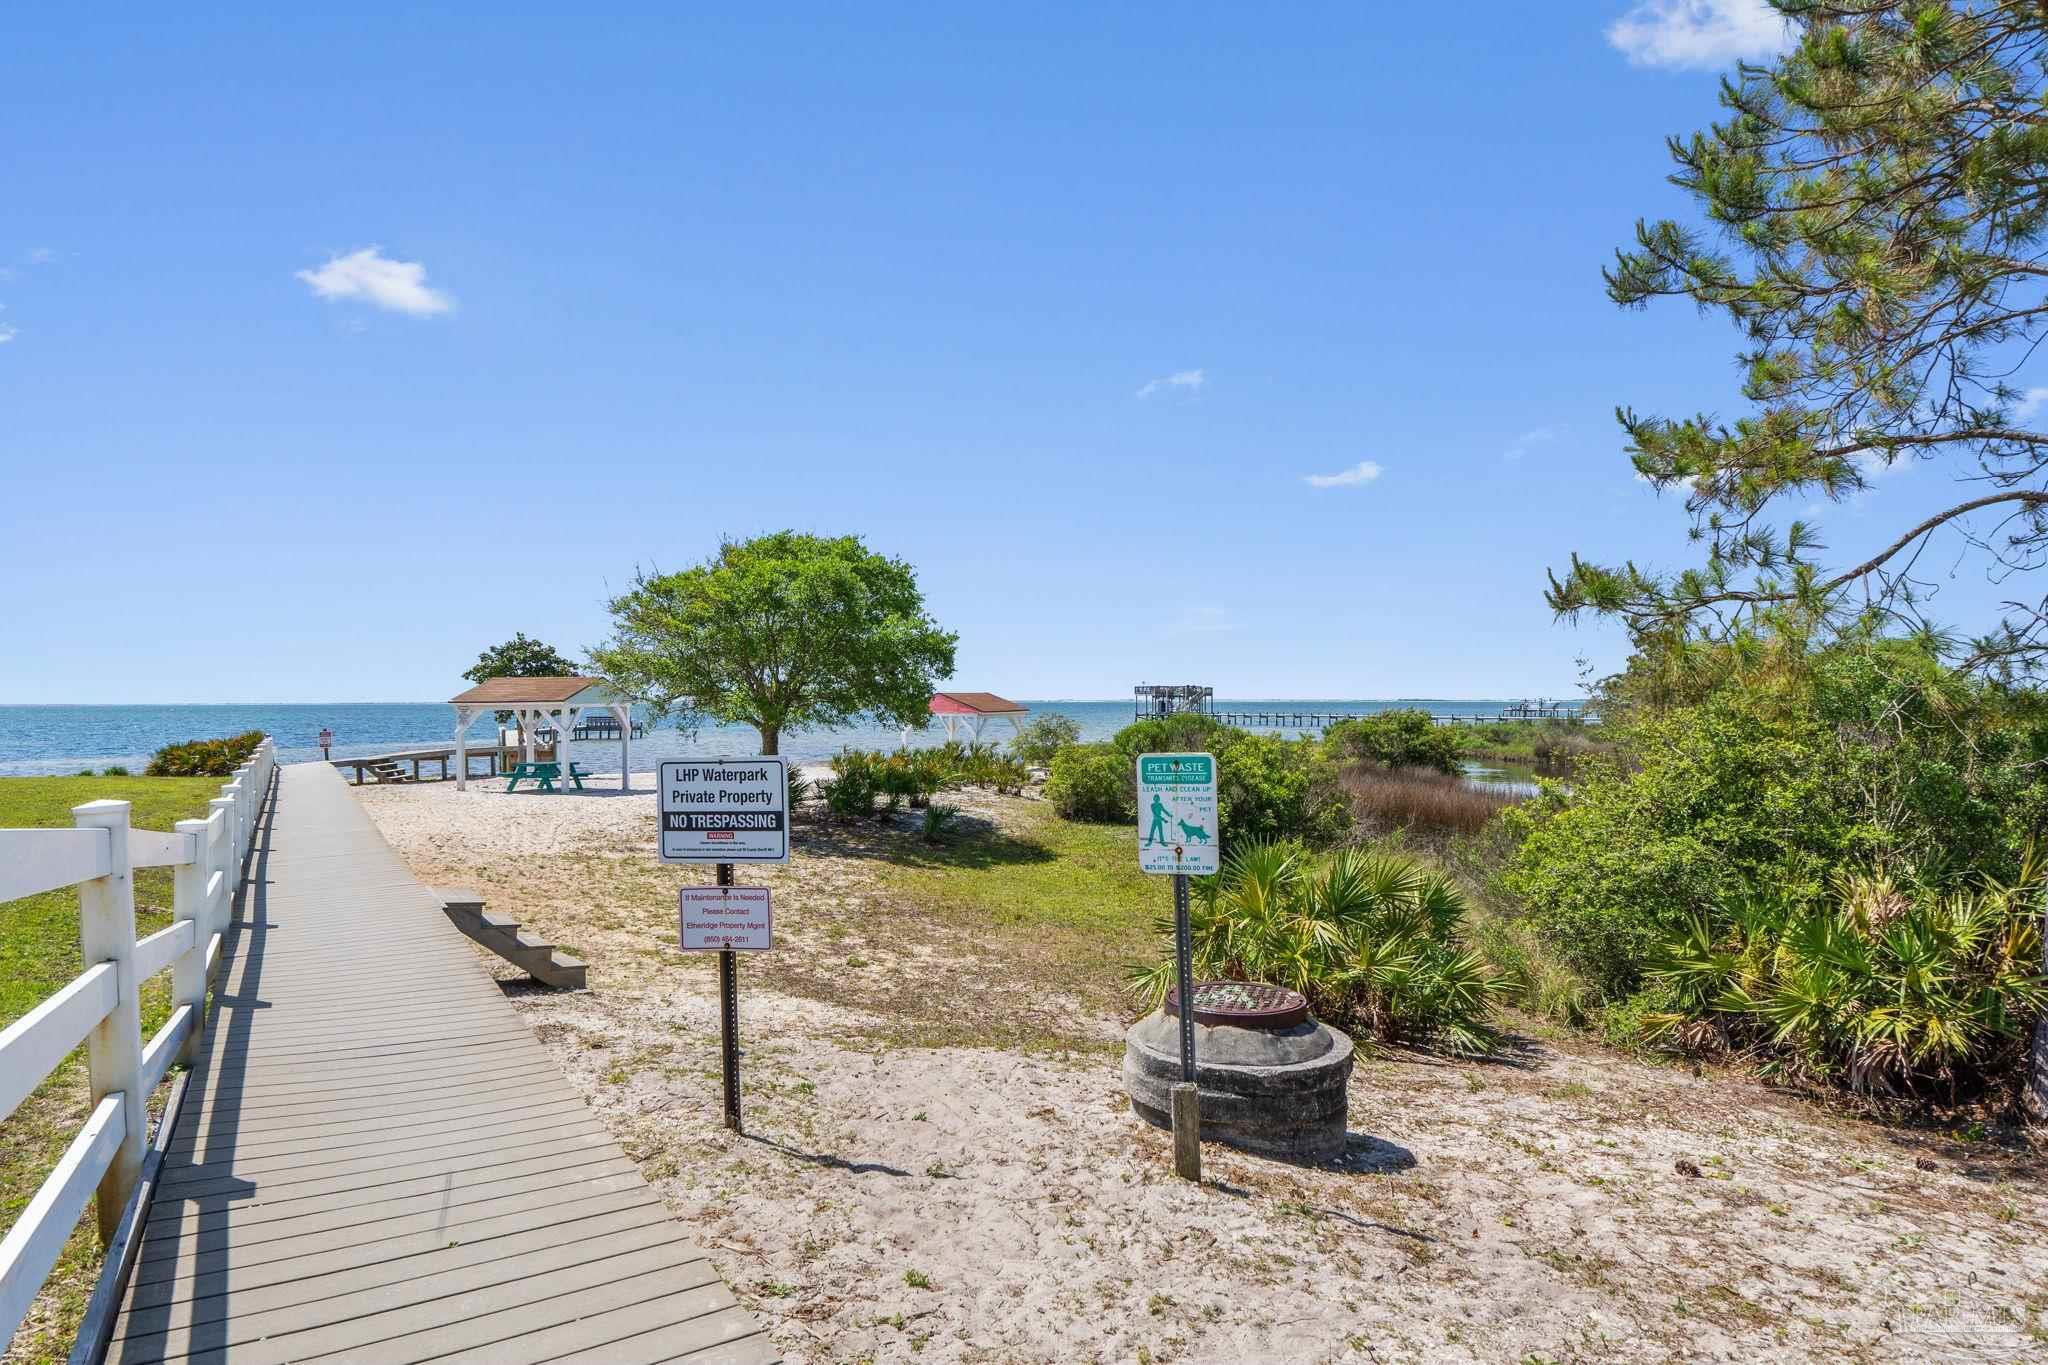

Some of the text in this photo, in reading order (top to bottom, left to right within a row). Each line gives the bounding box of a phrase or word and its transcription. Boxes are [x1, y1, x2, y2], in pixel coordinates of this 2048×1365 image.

[1148, 763, 1205, 773] PET WASTE
[676, 768, 768, 784] LHP Waterpark
[672, 790, 773, 806] Private Property
[670, 814, 776, 828] NO TRESPASSING
[719, 922, 745, 930] Property
